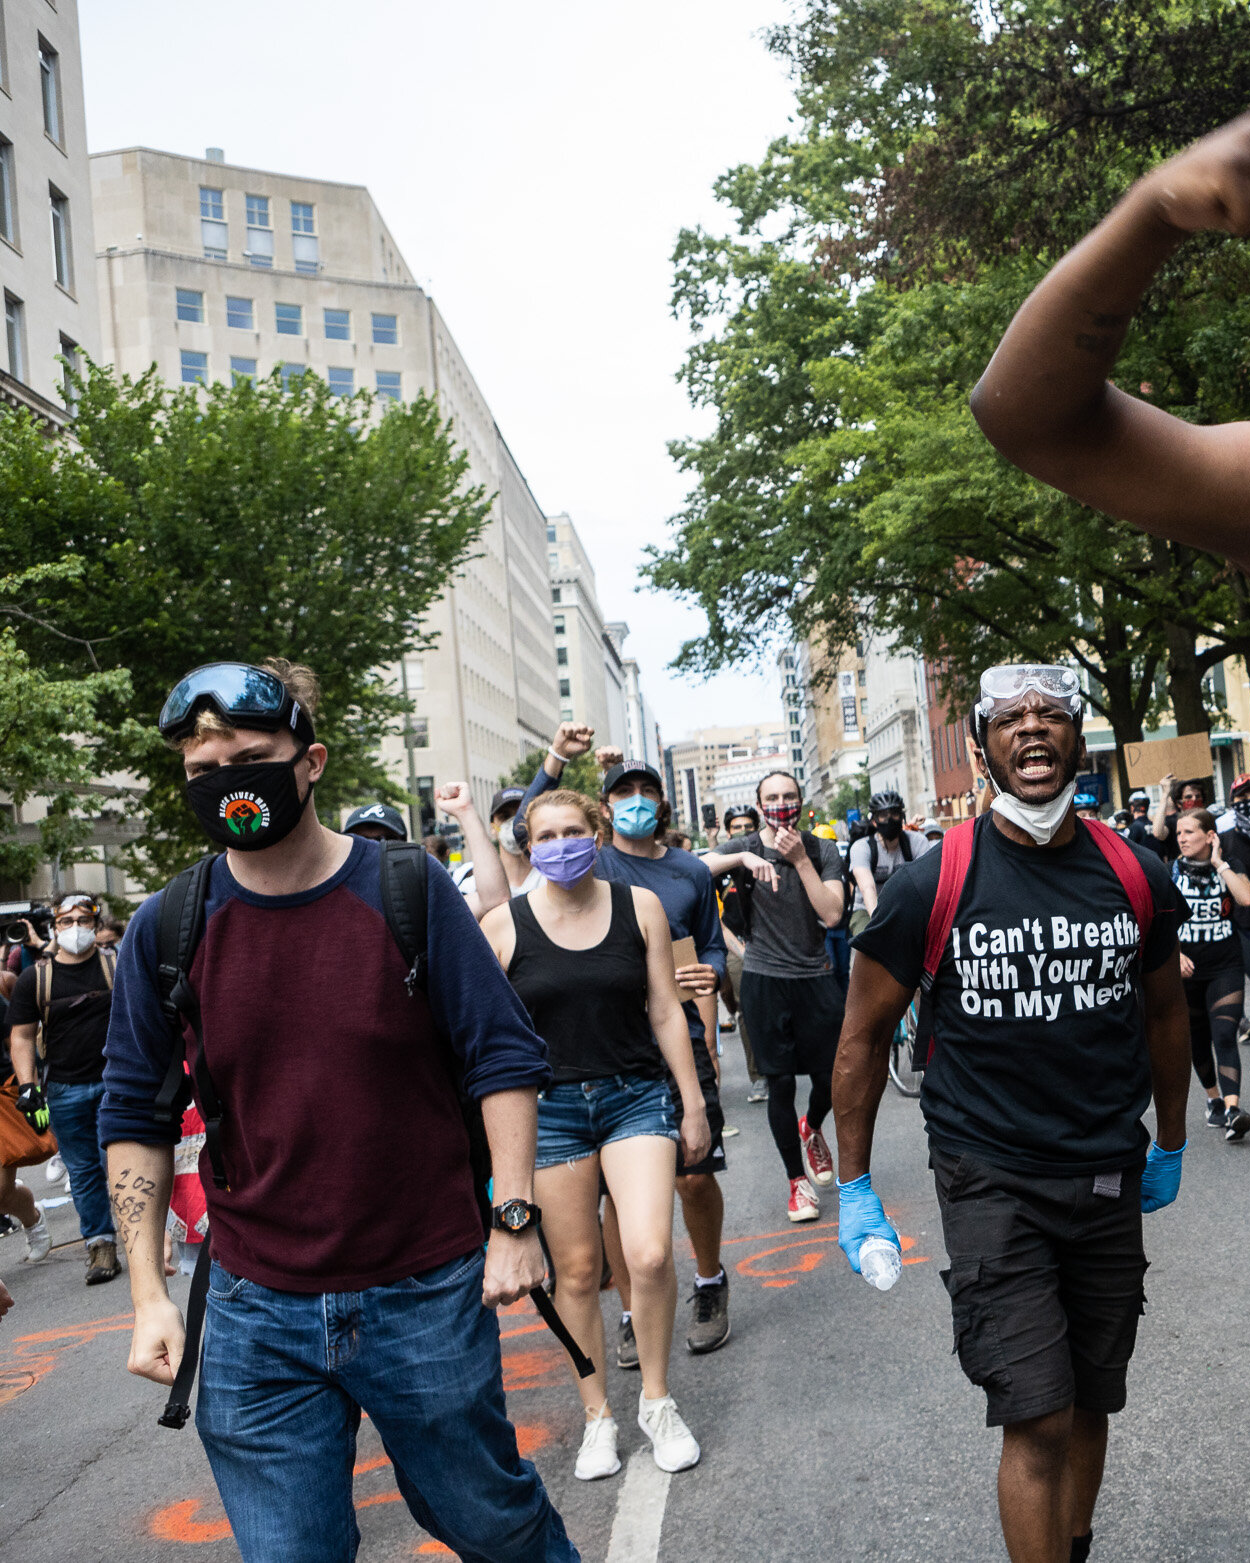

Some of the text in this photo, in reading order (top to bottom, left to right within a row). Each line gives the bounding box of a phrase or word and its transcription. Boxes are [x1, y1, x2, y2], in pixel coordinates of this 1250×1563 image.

[219, 791, 270, 828] BLACK LIVES MATTER
[952, 927, 961, 959] I
[969, 917, 1045, 957] Can't
[954, 957, 1019, 991] With
[1027, 953, 1094, 987] Your
[960, 989, 1003, 1018] On
[1014, 989, 1063, 1022] My
